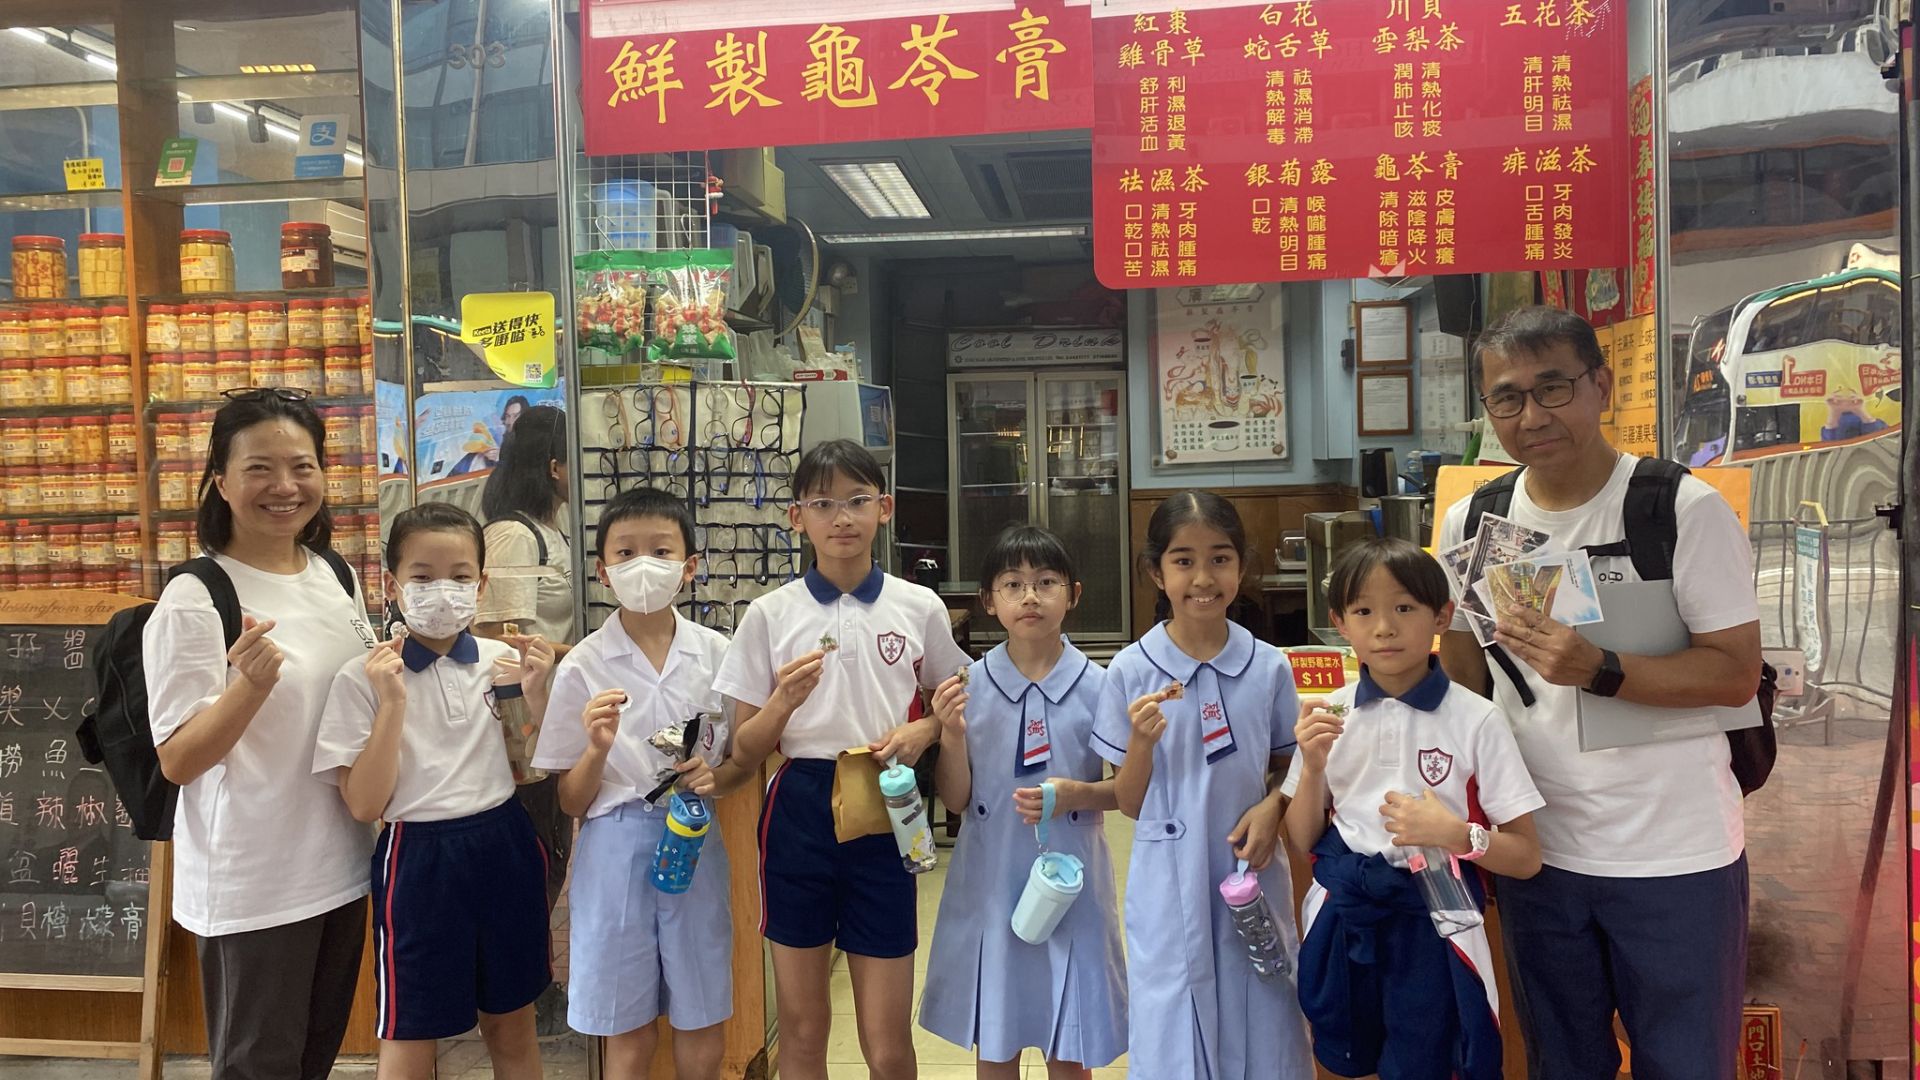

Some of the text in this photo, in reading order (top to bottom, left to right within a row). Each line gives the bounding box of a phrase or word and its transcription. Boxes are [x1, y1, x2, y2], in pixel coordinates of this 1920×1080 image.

[1134, 7, 1188, 33] 紅棗
[1244, 29, 1331, 60] 蛇舌草
[1260, 3, 1317, 26] 白花
[1373, 23, 1462, 53] 雪梨茶
[1504, 0, 1594, 27] 五花茶
[450, 41, 506, 70] 303
[607, 8, 1066, 123] 鮮製龜苓膏
[1120, 37, 1203, 67] 雞骨草
[1140, 77, 1159, 151] 舒肝活血
[1266, 70, 1285, 144] 清熱解毒
[1394, 64, 1413, 137] 潤肺止咳
[1422, 62, 1441, 137] 清熱化痰
[1524, 56, 1543, 131] 清肝明目
[1120, 164, 1208, 192] 祛濕茶
[1245, 159, 1335, 187] 銀菊露
[1375, 150, 1462, 181] 龜苓膏
[1504, 144, 1596, 173] 痱滋茶
[1125, 205, 1142, 276] 口乾口苦
[1151, 204, 1170, 276] 清熱祛濕
[1178, 203, 1196, 276] 牙肉腫痛
[1253, 199, 1270, 233] 口乾
[1280, 197, 1298, 270] 清熱明目
[1307, 196, 1326, 269] 喉嚨腫痛
[1380, 191, 1401, 268] 清除暗瘡
[1404, 190, 1426, 267] 滋陰降火
[1436, 189, 1454, 264] 皮膚痕癢
[1526, 186, 1544, 260] 口舌腫痛
[1554, 184, 1572, 259] 牙肉發炎
[492, 313, 540, 334] 送得快
[1302, 672, 1333, 686] $11
